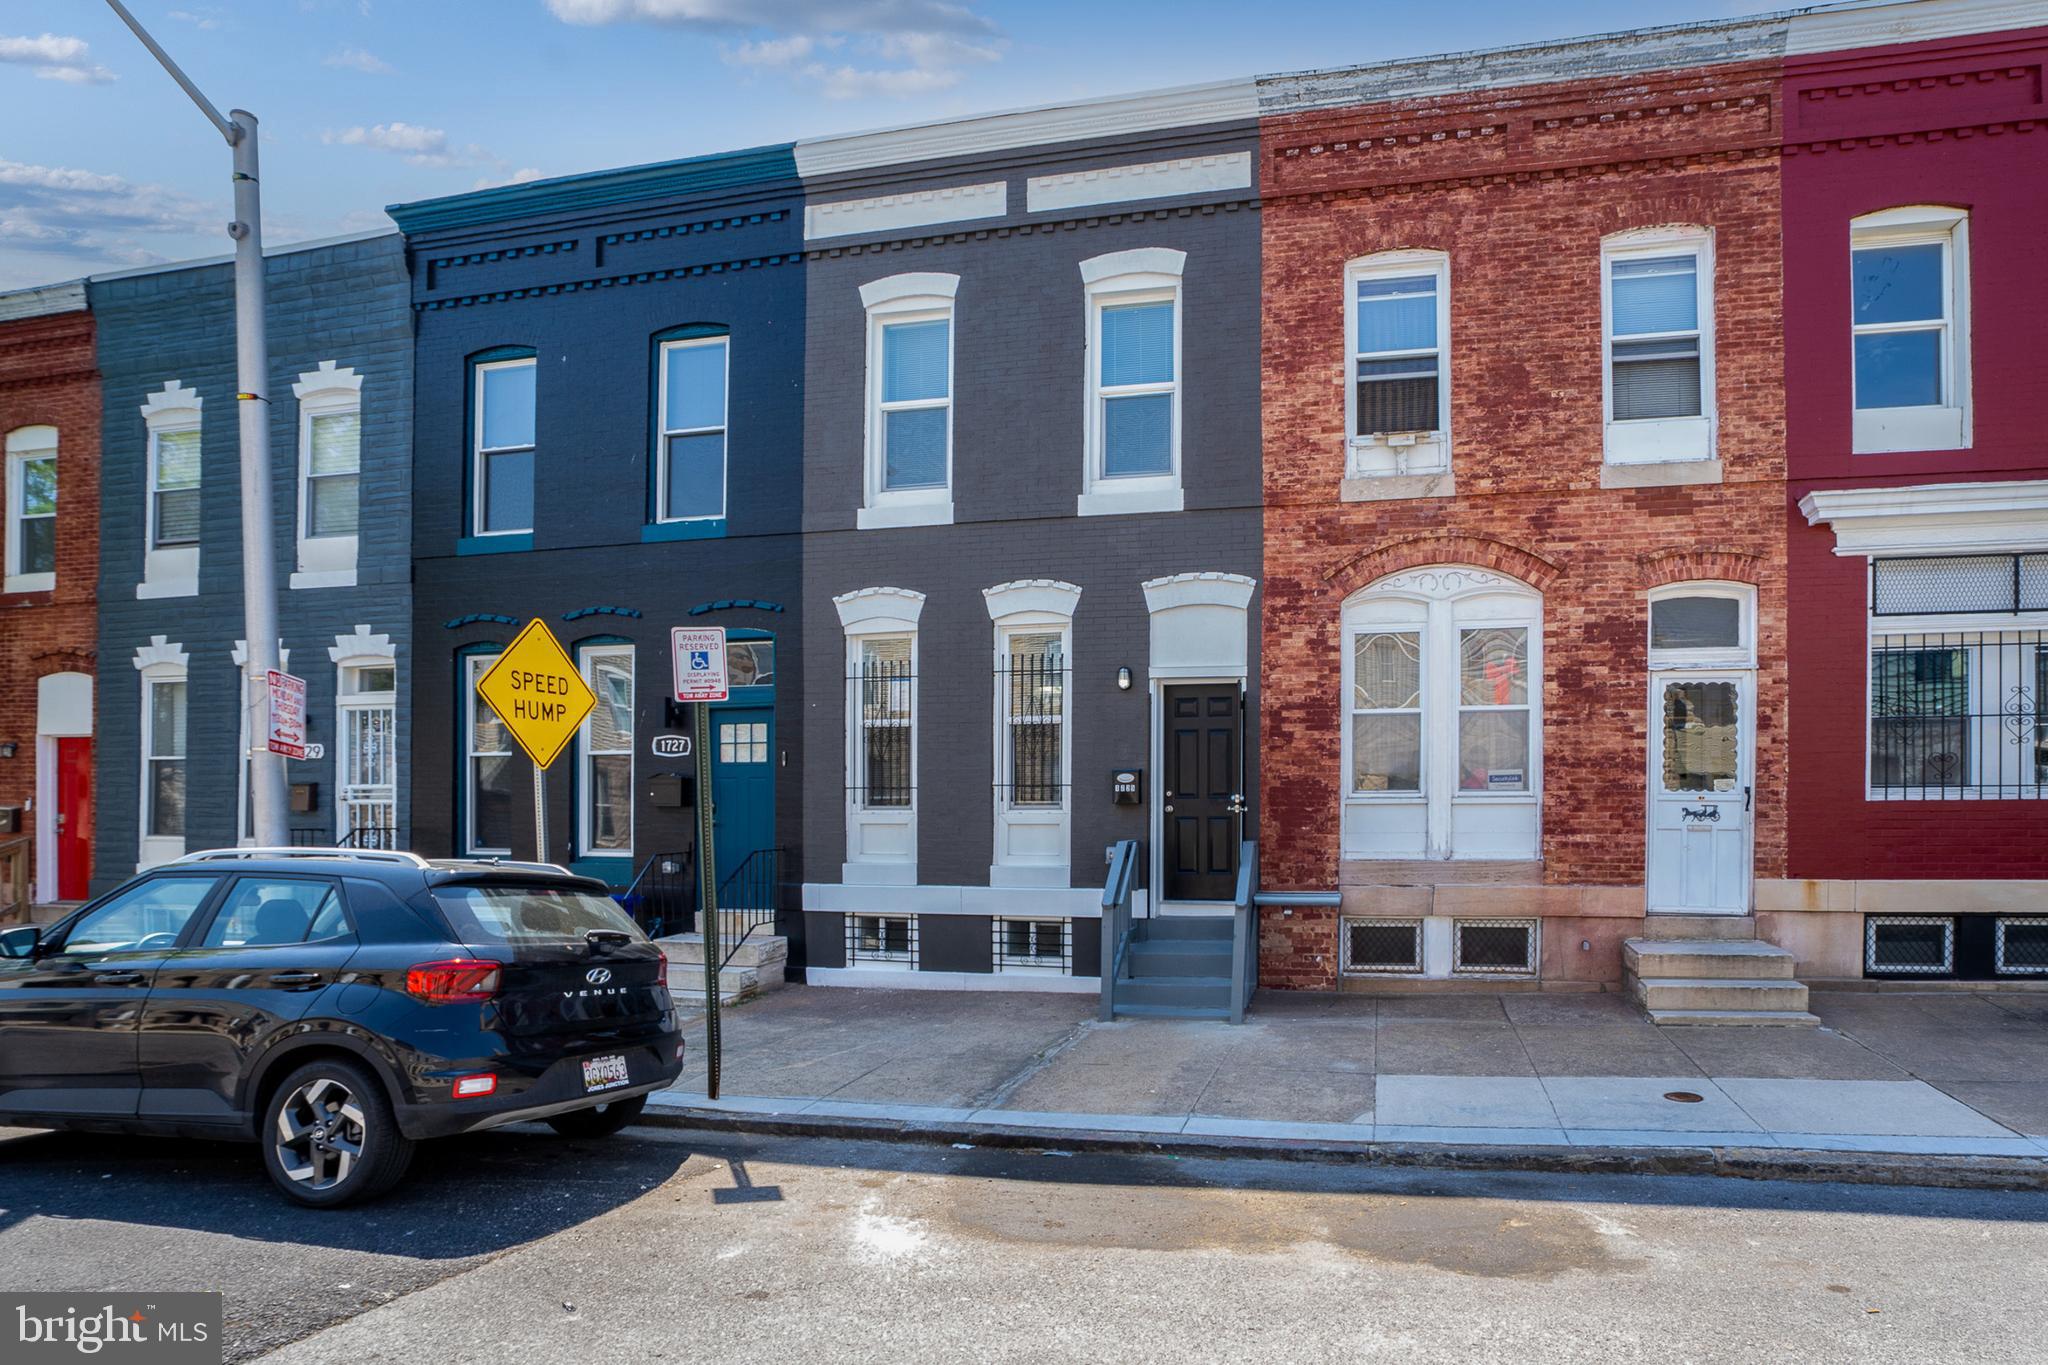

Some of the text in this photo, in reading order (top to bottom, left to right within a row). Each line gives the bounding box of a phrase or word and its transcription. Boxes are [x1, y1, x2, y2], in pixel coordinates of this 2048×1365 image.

[682, 634, 715, 642] PARKING
[679, 643, 719, 651] RESERVED
[511, 670, 569, 695] SPEED
[514, 699, 566, 722] HUMP
[661, 739, 686, 752] 1727
[563, 987, 628, 998] VENUE
